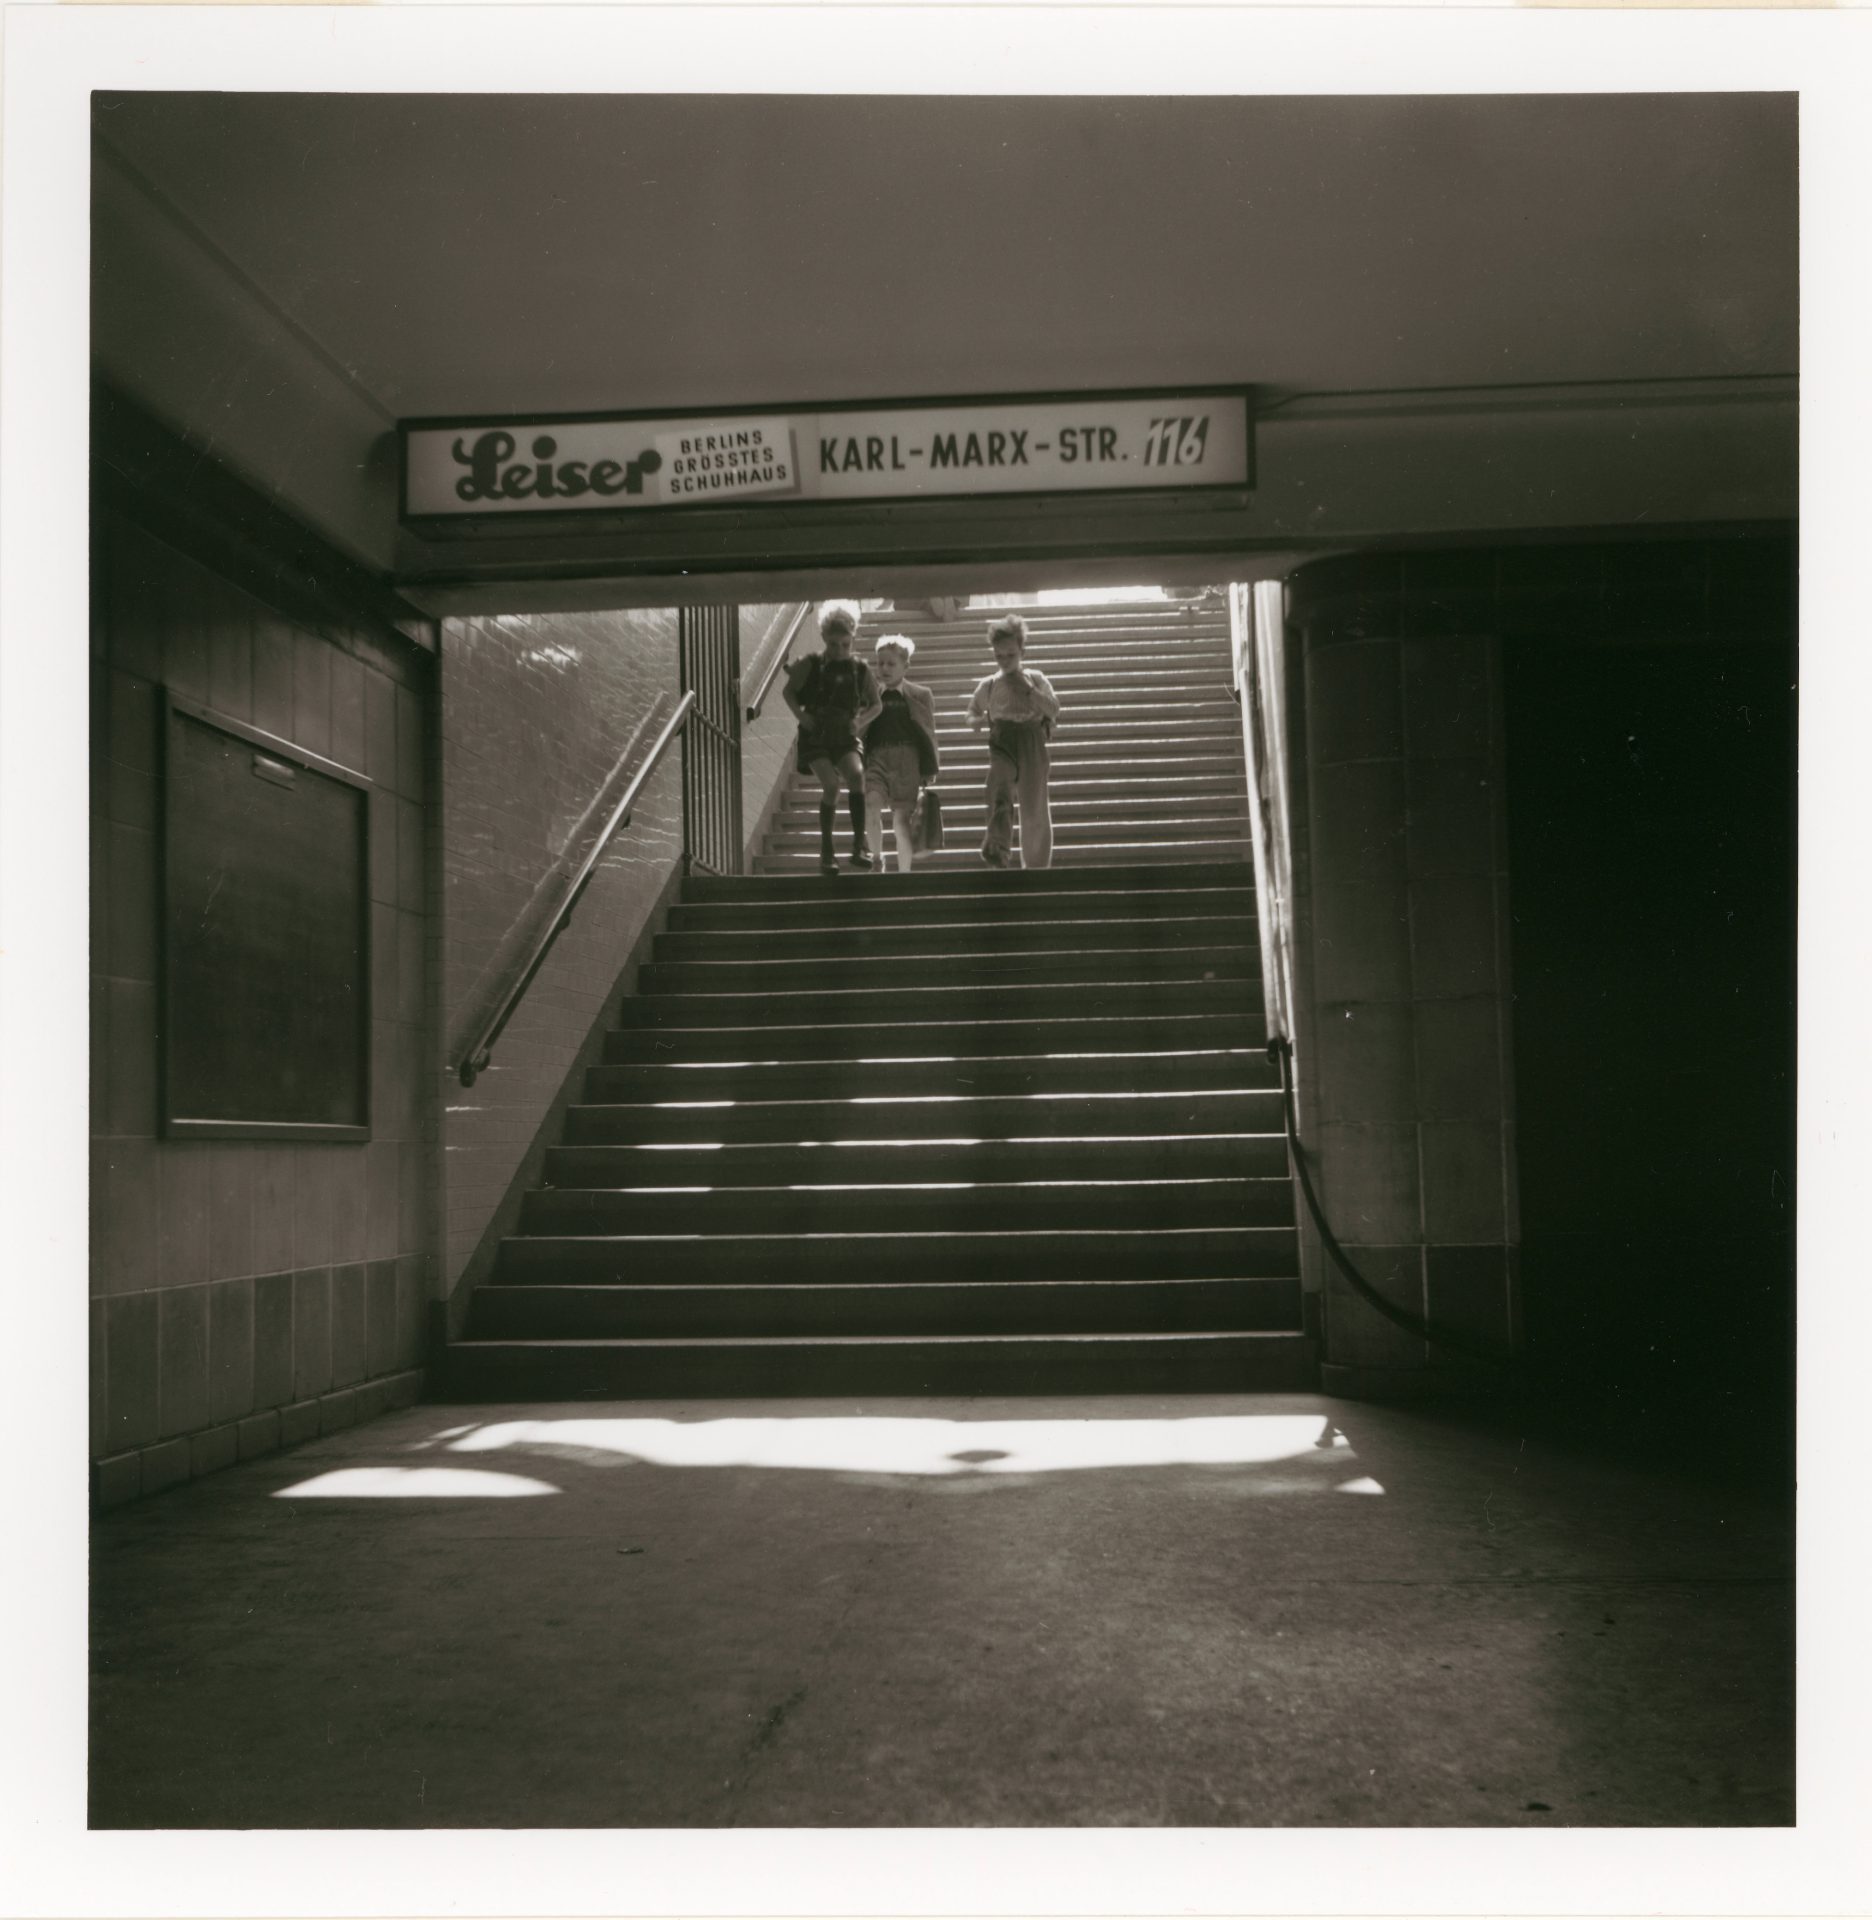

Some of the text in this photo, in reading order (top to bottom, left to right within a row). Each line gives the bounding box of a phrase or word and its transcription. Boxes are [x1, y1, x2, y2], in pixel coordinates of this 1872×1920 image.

[680, 429, 763, 455] BERLINS
[819, 416, 1210, 473] KARL-MARX-STR. 116
[452, 431, 662, 501] Leiser
[673, 446, 775, 475] GRÖSSTES
[670, 464, 787, 494] SCHUHHAUS
